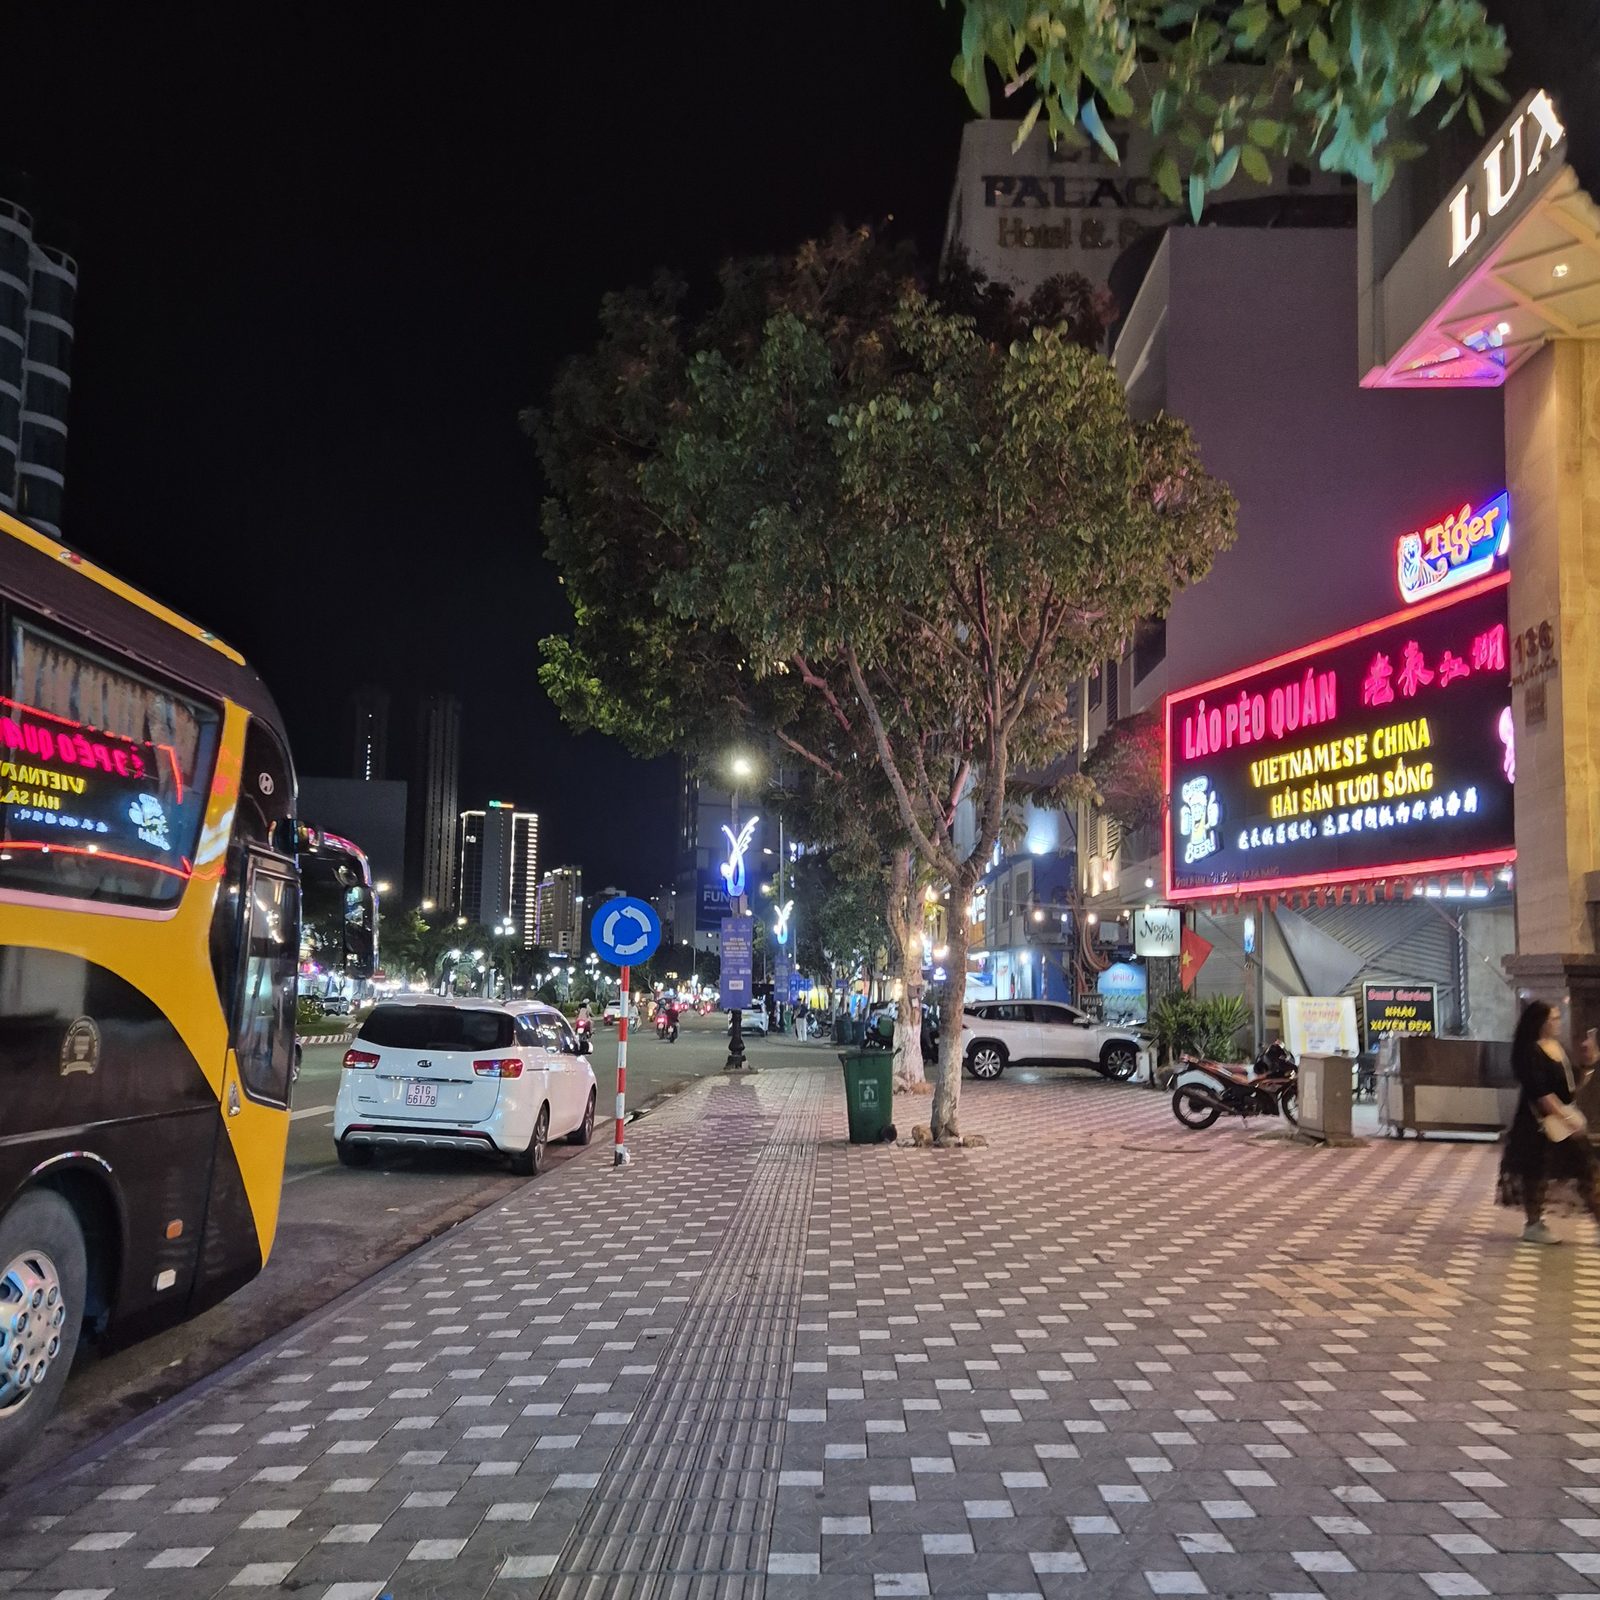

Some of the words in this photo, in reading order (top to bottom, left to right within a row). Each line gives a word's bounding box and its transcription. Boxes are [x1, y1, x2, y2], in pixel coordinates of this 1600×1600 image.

[982, 175, 1190, 208] PALAC
[1448, 88, 1565, 267] LUX
[1422, 503, 1499, 566] Tiger
[1185, 699, 1222, 760] LẢO
[1271, 667, 1337, 740] QUÁN
[1251, 732, 1369, 788] VIETNAMESE
[1372, 717, 1432, 760] CHINA
[1271, 785, 1299, 818] HẢI
[1302, 779, 1334, 813] SẢN
[1336, 772, 1379, 806] TƯƠI
[1383, 757, 1434, 798] SỐNG
[415, 1085, 431, 1095] 51G
